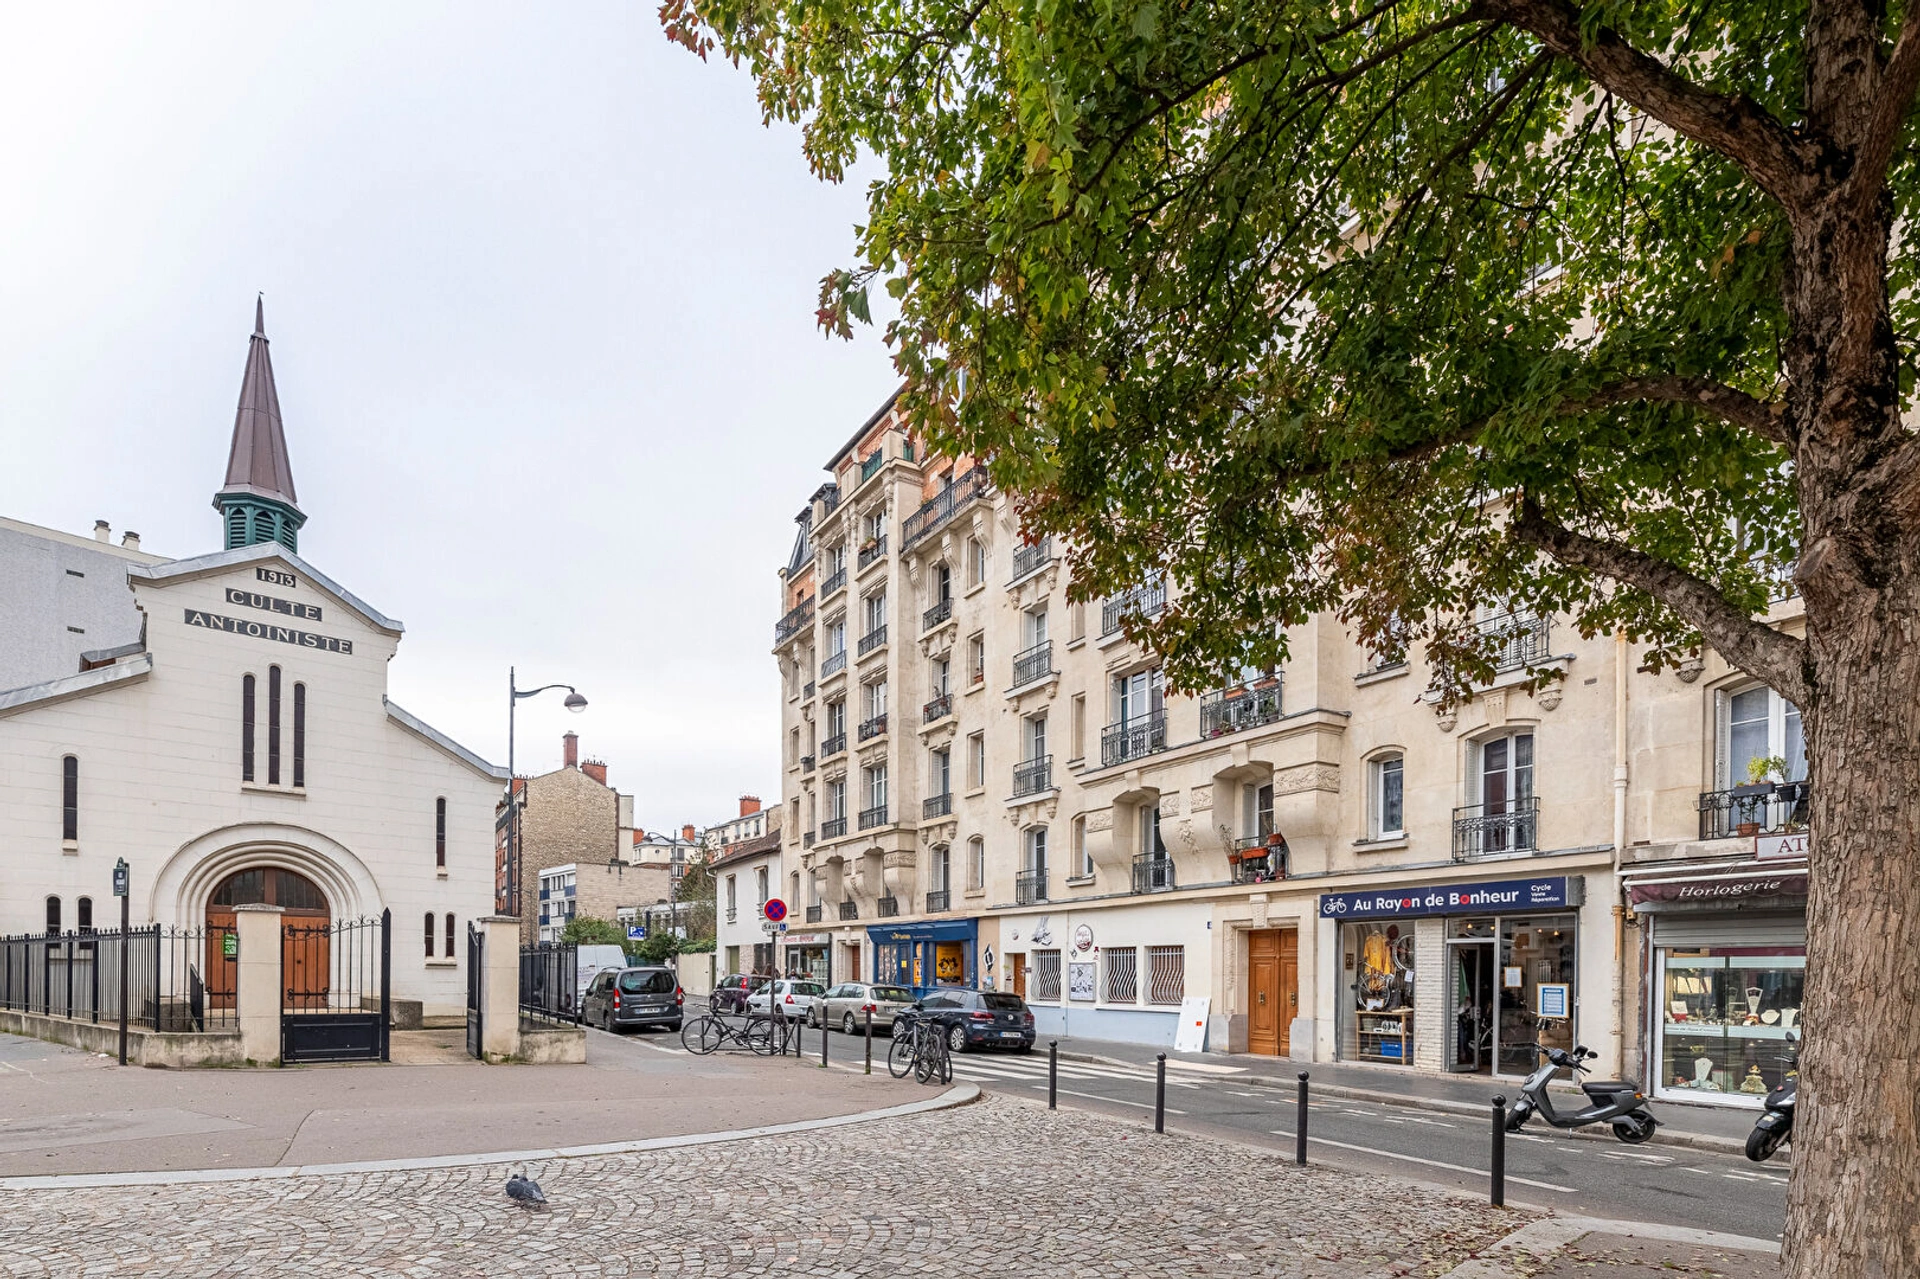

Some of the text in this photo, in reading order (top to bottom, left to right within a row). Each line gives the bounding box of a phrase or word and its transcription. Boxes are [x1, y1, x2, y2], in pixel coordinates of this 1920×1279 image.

[260, 569, 295, 587] 1913
[230, 590, 319, 621] CULTE
[190, 612, 351, 655] ANTOINISTE
[1531, 884, 1552, 892] Cycle
[1679, 880, 1781, 897] Horlogerie
[1353, 889, 1519, 912] Au Rayon de Bonheur
